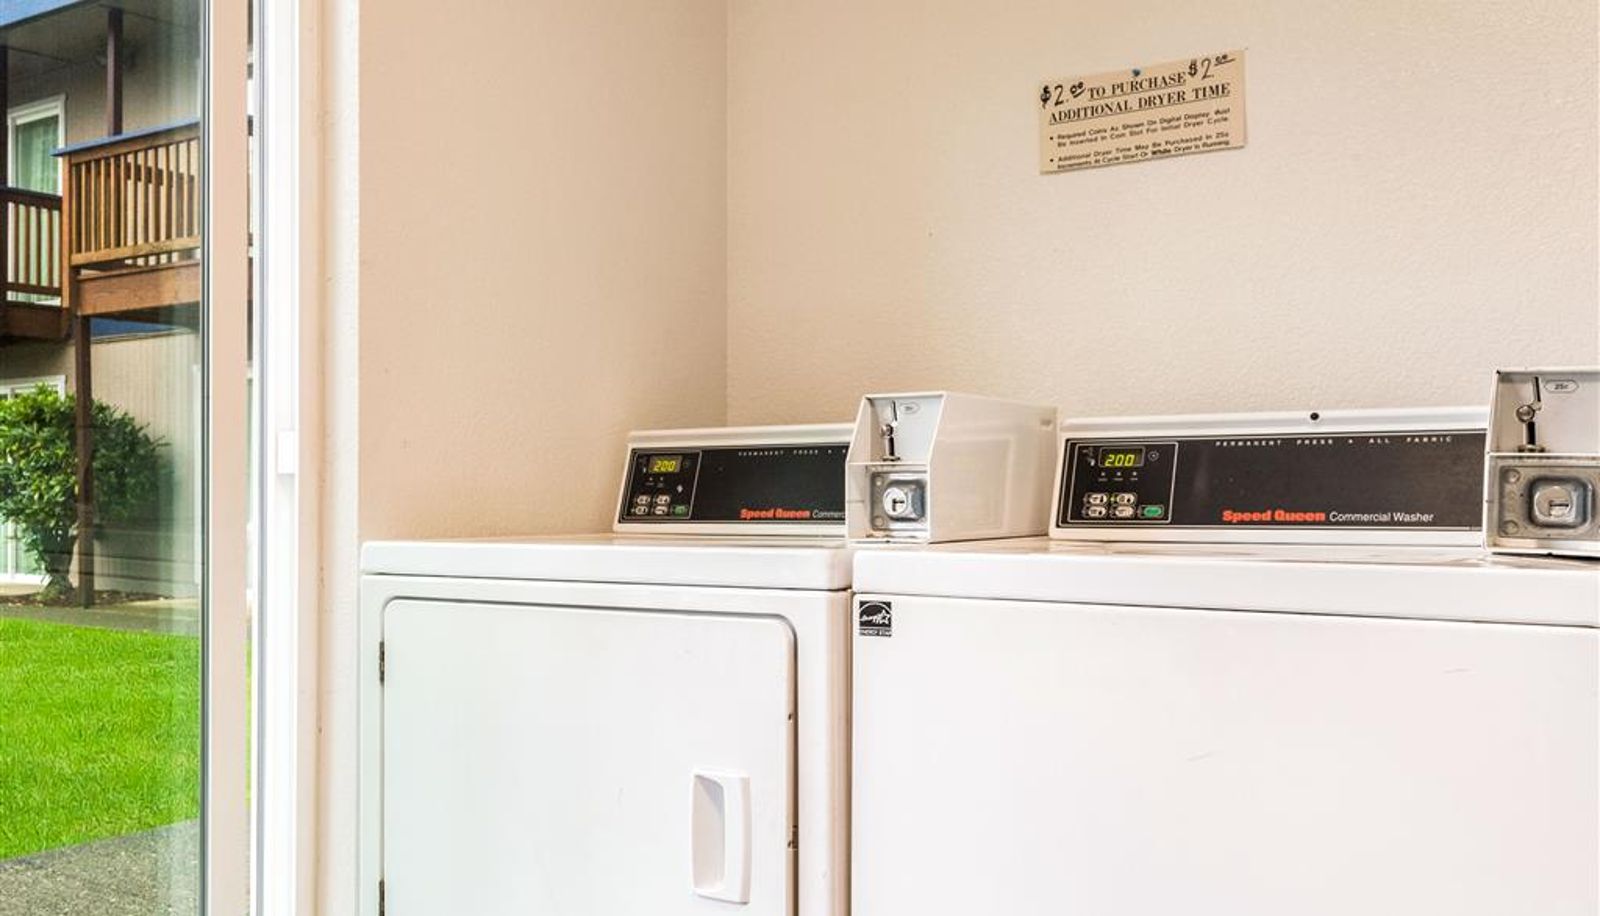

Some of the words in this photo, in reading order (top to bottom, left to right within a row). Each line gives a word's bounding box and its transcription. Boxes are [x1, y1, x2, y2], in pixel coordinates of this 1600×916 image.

[1087, 86, 1106, 99] TO
[1111, 72, 1187, 96] PURCHASE
[1049, 99, 1133, 123] ADDITIONAL
[1138, 90, 1186, 109] DRYER
[1192, 82, 1231, 100] TIME
[1159, 115, 1182, 124] Digital
[1183, 112, 1210, 121] Display
[1183, 120, 1204, 128] Dryer
[1058, 152, 1092, 162] Additional
[1093, 149, 1112, 157] Dryer
[1164, 135, 1203, 146] Purchased
[1173, 145, 1193, 153] Dryer
[1406, 435, 1452, 443] FABRIC
[1104, 453, 1135, 467] 200
[740, 508, 774, 521] Speed
[775, 508, 811, 519] Queen
[1222, 510, 1272, 523] Speed
[1274, 509, 1326, 522] Queen
[1328, 510, 1392, 522] Commercial
[1392, 511, 1435, 522] Washer
